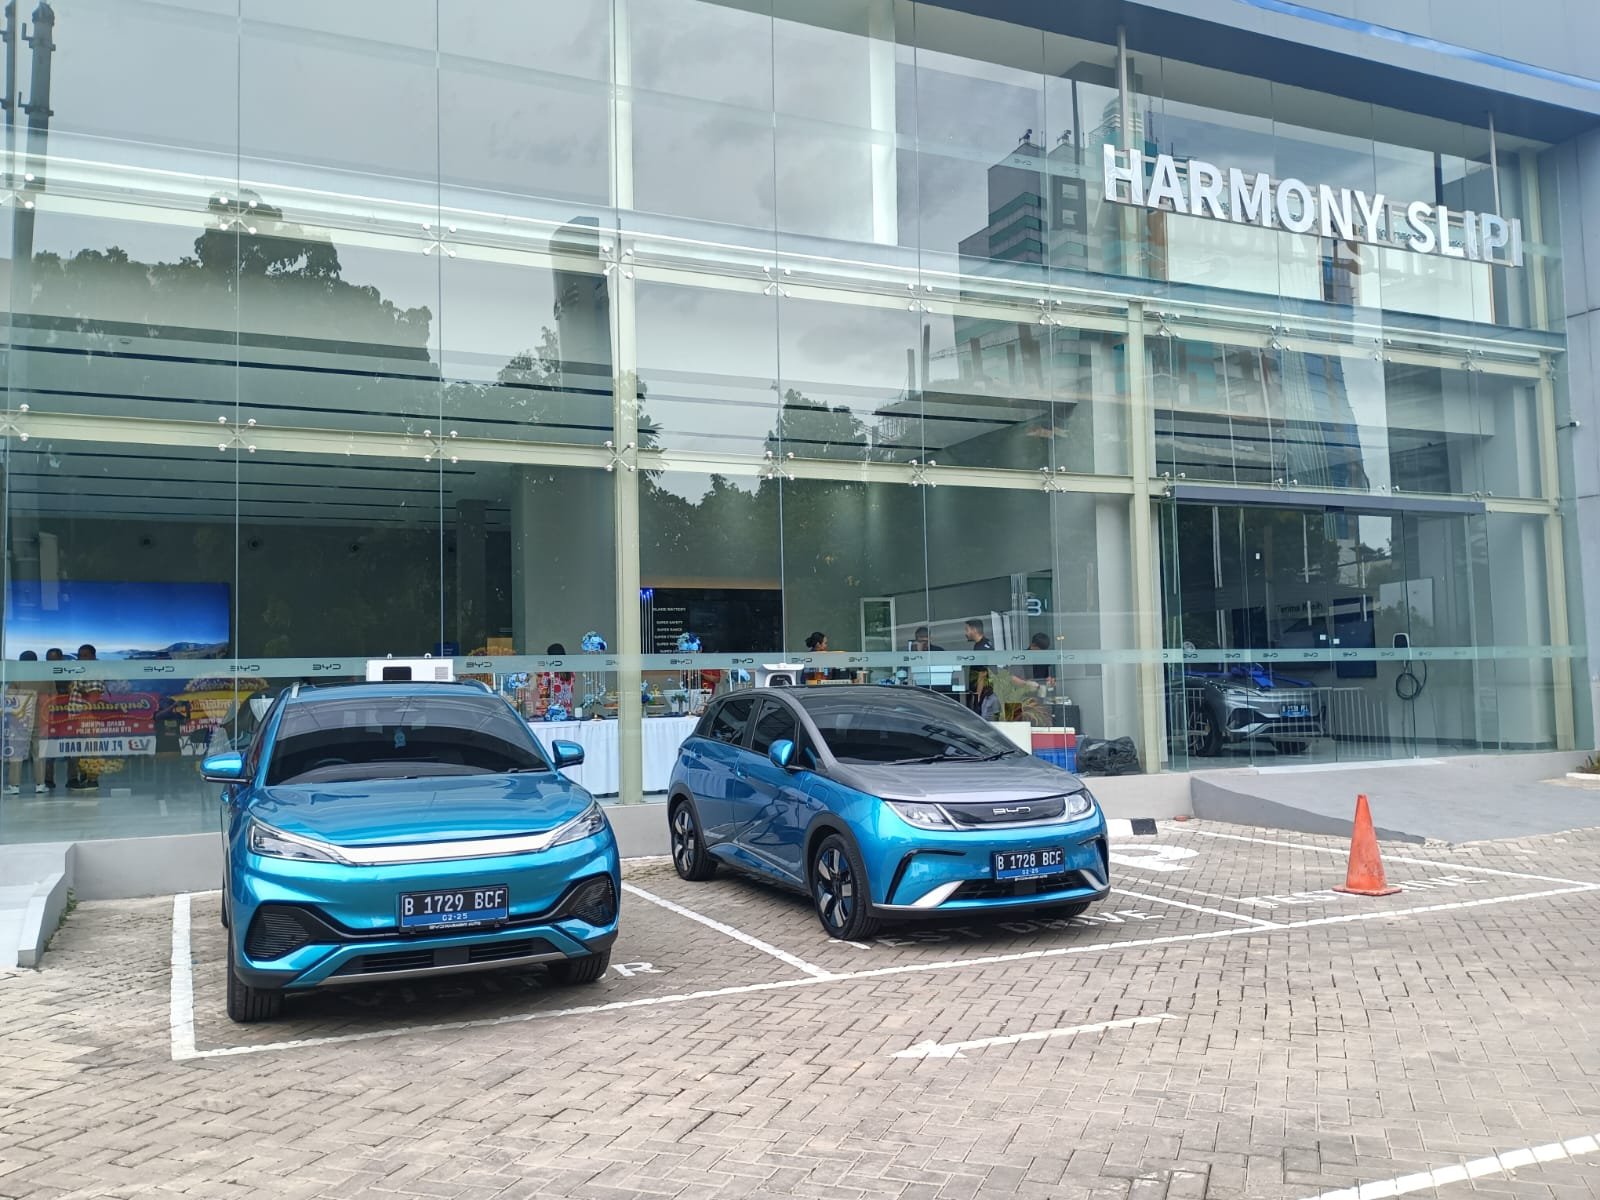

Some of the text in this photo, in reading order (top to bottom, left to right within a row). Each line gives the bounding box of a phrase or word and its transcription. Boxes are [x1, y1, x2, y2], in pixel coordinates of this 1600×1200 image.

[1103, 143, 1523, 267] HARMONY SLIPI
[144, 665, 175, 673] BYD
[229, 664, 261, 672] BYD
[312, 663, 342, 671] BYD
[992, 806, 1031, 816] BYD
[998, 851, 1062, 870] B 1728 BCF
[404, 890, 504, 916] B 1729 BCF
